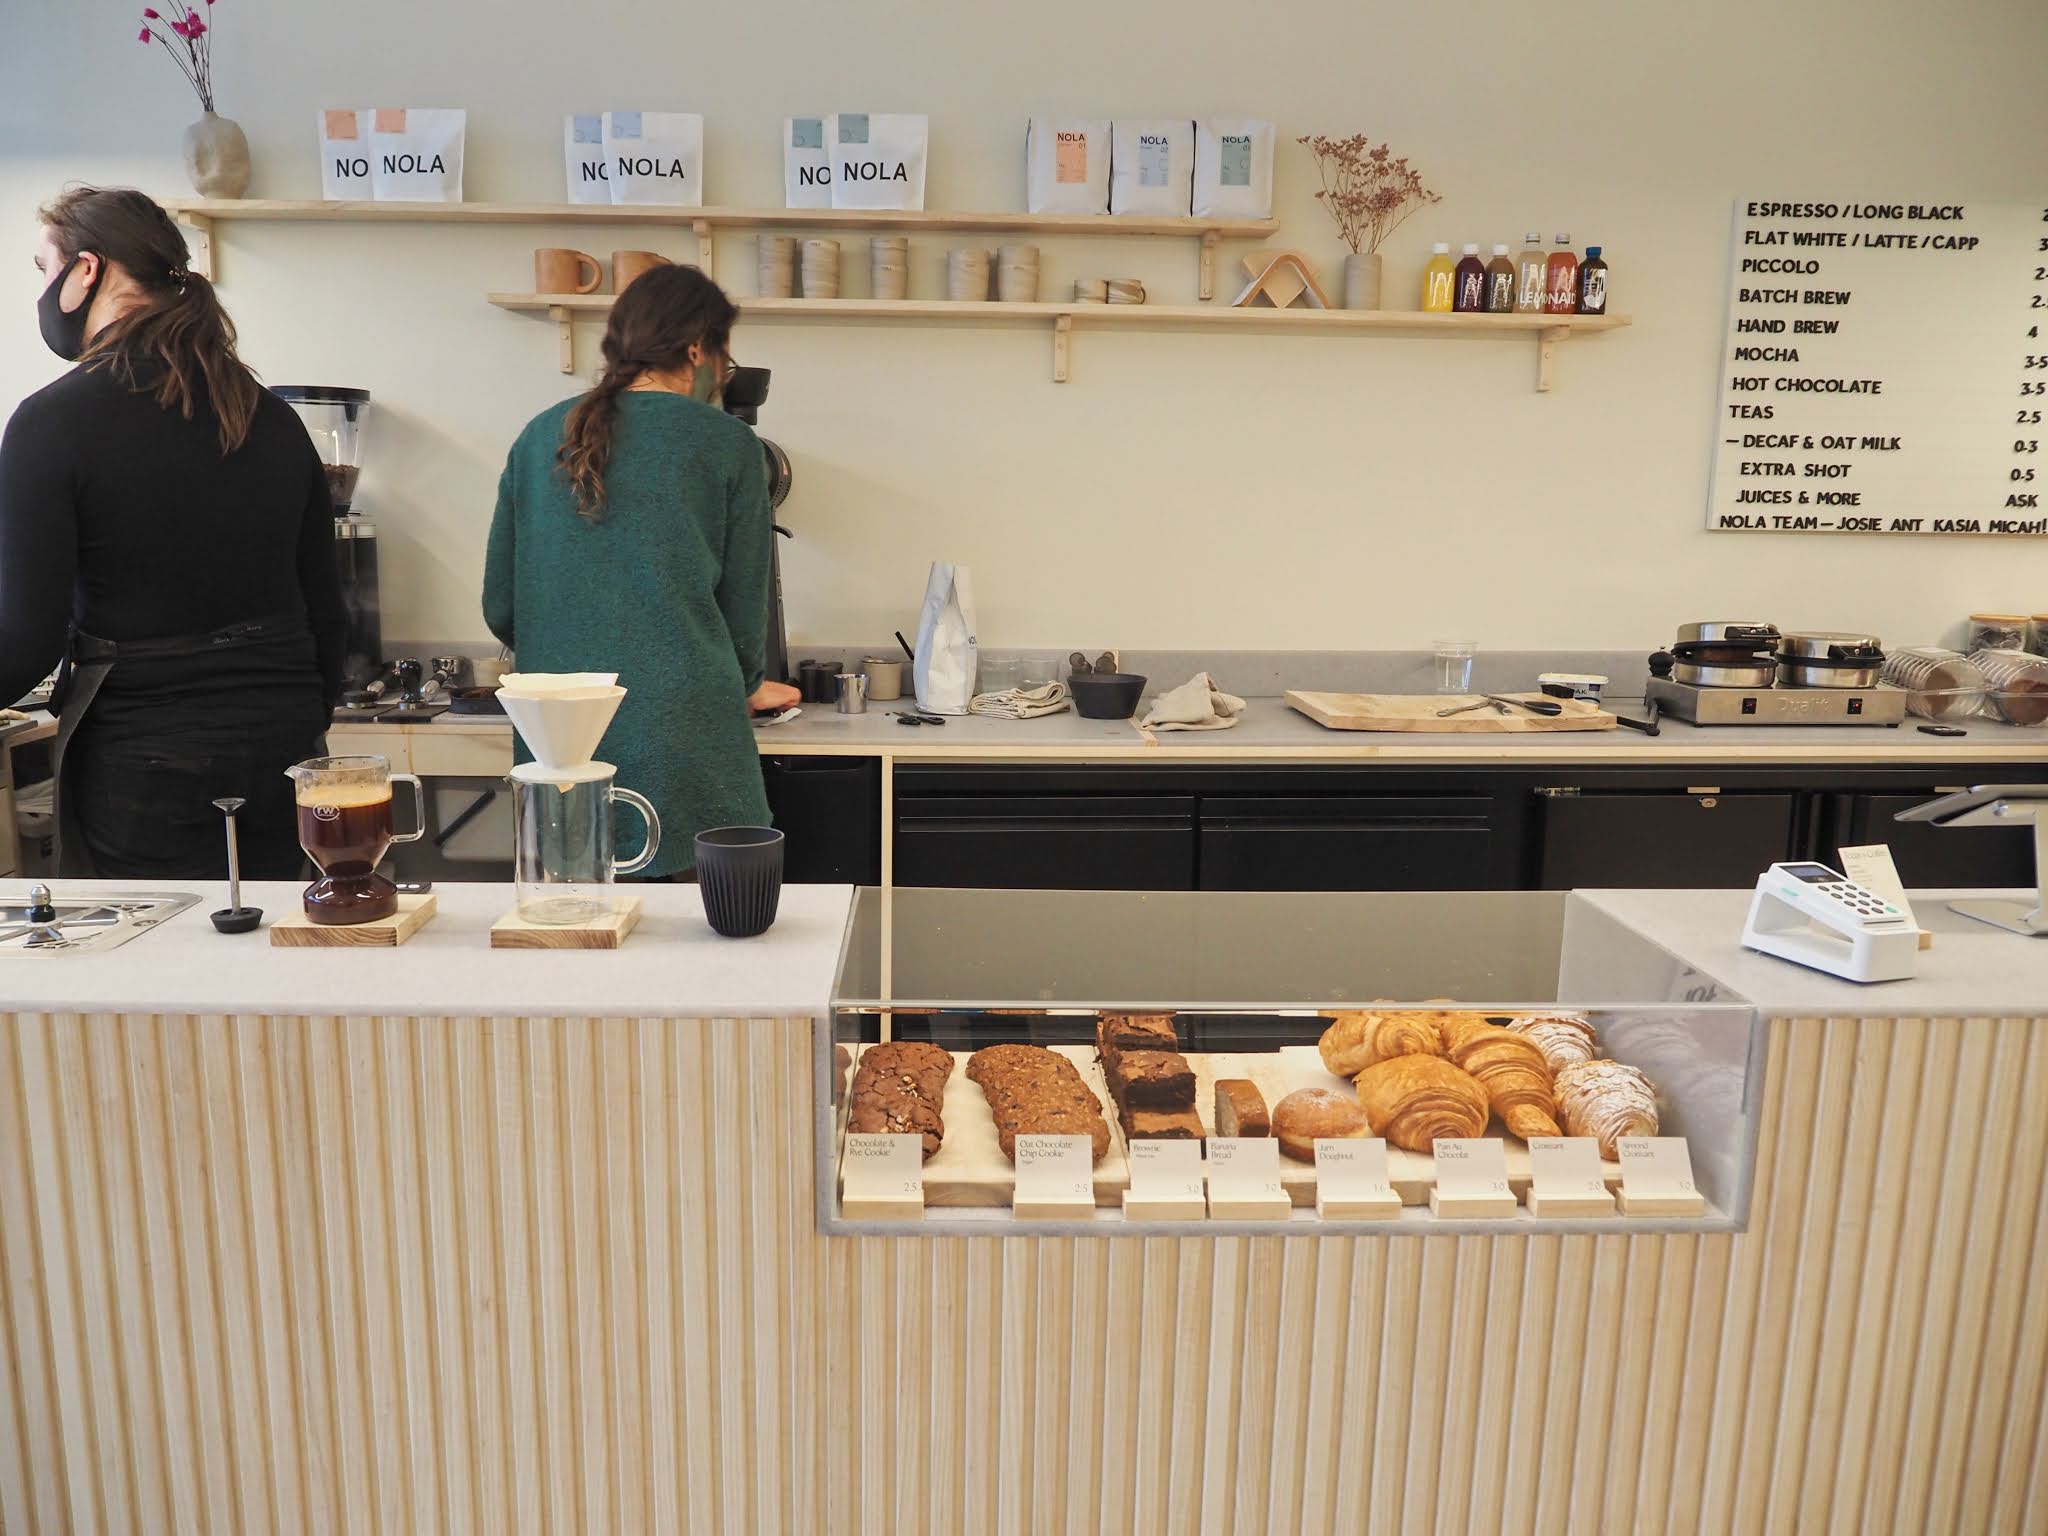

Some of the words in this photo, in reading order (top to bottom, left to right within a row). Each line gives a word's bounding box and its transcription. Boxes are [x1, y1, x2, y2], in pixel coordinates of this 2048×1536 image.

[1057, 132, 1085, 142] NOLA
[1140, 135, 1168, 145] NOLA
[1222, 135, 1251, 144] NOLA
[336, 158, 369, 178] NO
[383, 154, 446, 174] NOLA
[582, 161, 609, 182] NO
[618, 157, 685, 179] NOLA
[844, 161, 908, 182] NOLA
[799, 166, 832, 186] NO
[1747, 202, 1839, 219] ESPRESSO
[1852, 203, 1904, 220] LONG
[1907, 205, 1965, 221] BLACK
[1744, 230, 1790, 245] FLAT
[1792, 231, 1848, 248] WHITE
[1864, 233, 1919, 249] LATTE
[1932, 234, 1979, 251] CAPP
[1741, 258, 1820, 275] PICCOLO
[1739, 288, 1799, 305] BATCH
[1803, 290, 1852, 306] BREW
[1737, 318, 1786, 334] HAND
[1793, 319, 1840, 334] BREW
[2027, 325, 2038, 338] 4
[1734, 347, 1800, 362] MOCHA
[1732, 376, 1770, 392] HOT
[1774, 377, 1883, 395] CHOCOLATE
[2020, 382, 2046, 396] 3.5
[1728, 404, 1774, 420] TEAS
[2017, 410, 2042, 424] 2.5
[1743, 434, 1800, 449] DECAF
[1802, 435, 1814, 450] &
[1820, 435, 1857, 450] OAT
[1861, 436, 1901, 451] MILK
[2014, 439, 2039, 453] 0.3
[1740, 462, 1796, 477] EXTRA
[1804, 463, 1852, 479] SHOT
[2010, 468, 2035, 482] 0.5
[1735, 489, 1793, 504] JUICES
[1798, 490, 1810, 505] &
[1816, 491, 1861, 506] MORE
[2005, 494, 2039, 508] ASK
[1719, 515, 1767, 529] NOLA
[1889, 518, 1924, 532] ANT
[1933, 519, 1981, 533] KASIA
[1988, 518, 2048, 534] MICAH!
[849, 1137, 888, 1148] Chocolate
[1019, 1139, 1034, 1149] Oat
[1035, 1139, 1073, 1149] Chocolate
[849, 1148, 863, 1157] Rye
[1019, 1148, 1037, 1159] Chip
[1038, 1148, 1065, 1158] Cookie
